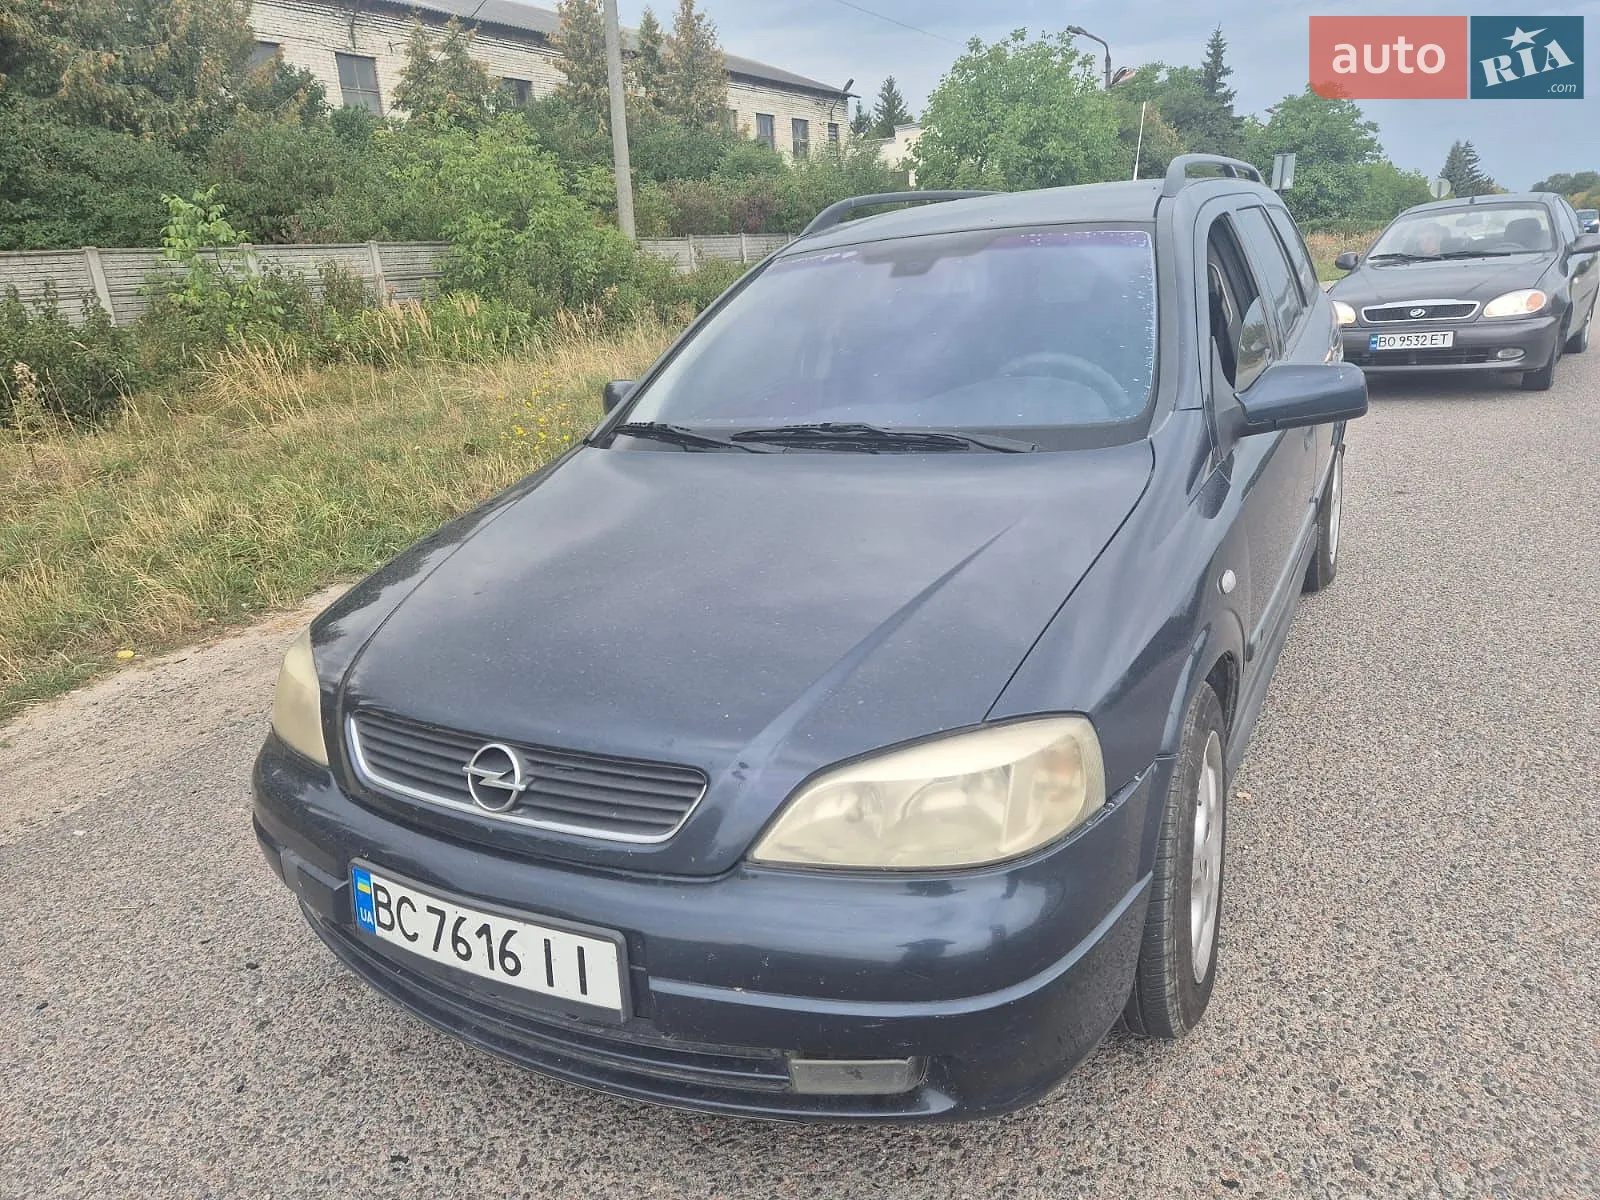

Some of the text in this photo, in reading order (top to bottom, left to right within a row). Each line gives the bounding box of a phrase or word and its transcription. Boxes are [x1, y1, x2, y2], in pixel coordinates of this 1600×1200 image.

[1378, 336, 1396, 347] BO
[1399, 335, 1428, 346] 9532
[1431, 334, 1449, 346] ET
[359, 907, 374, 925] UA
[373, 883, 419, 943] BC
[426, 905, 522, 976] 7616
